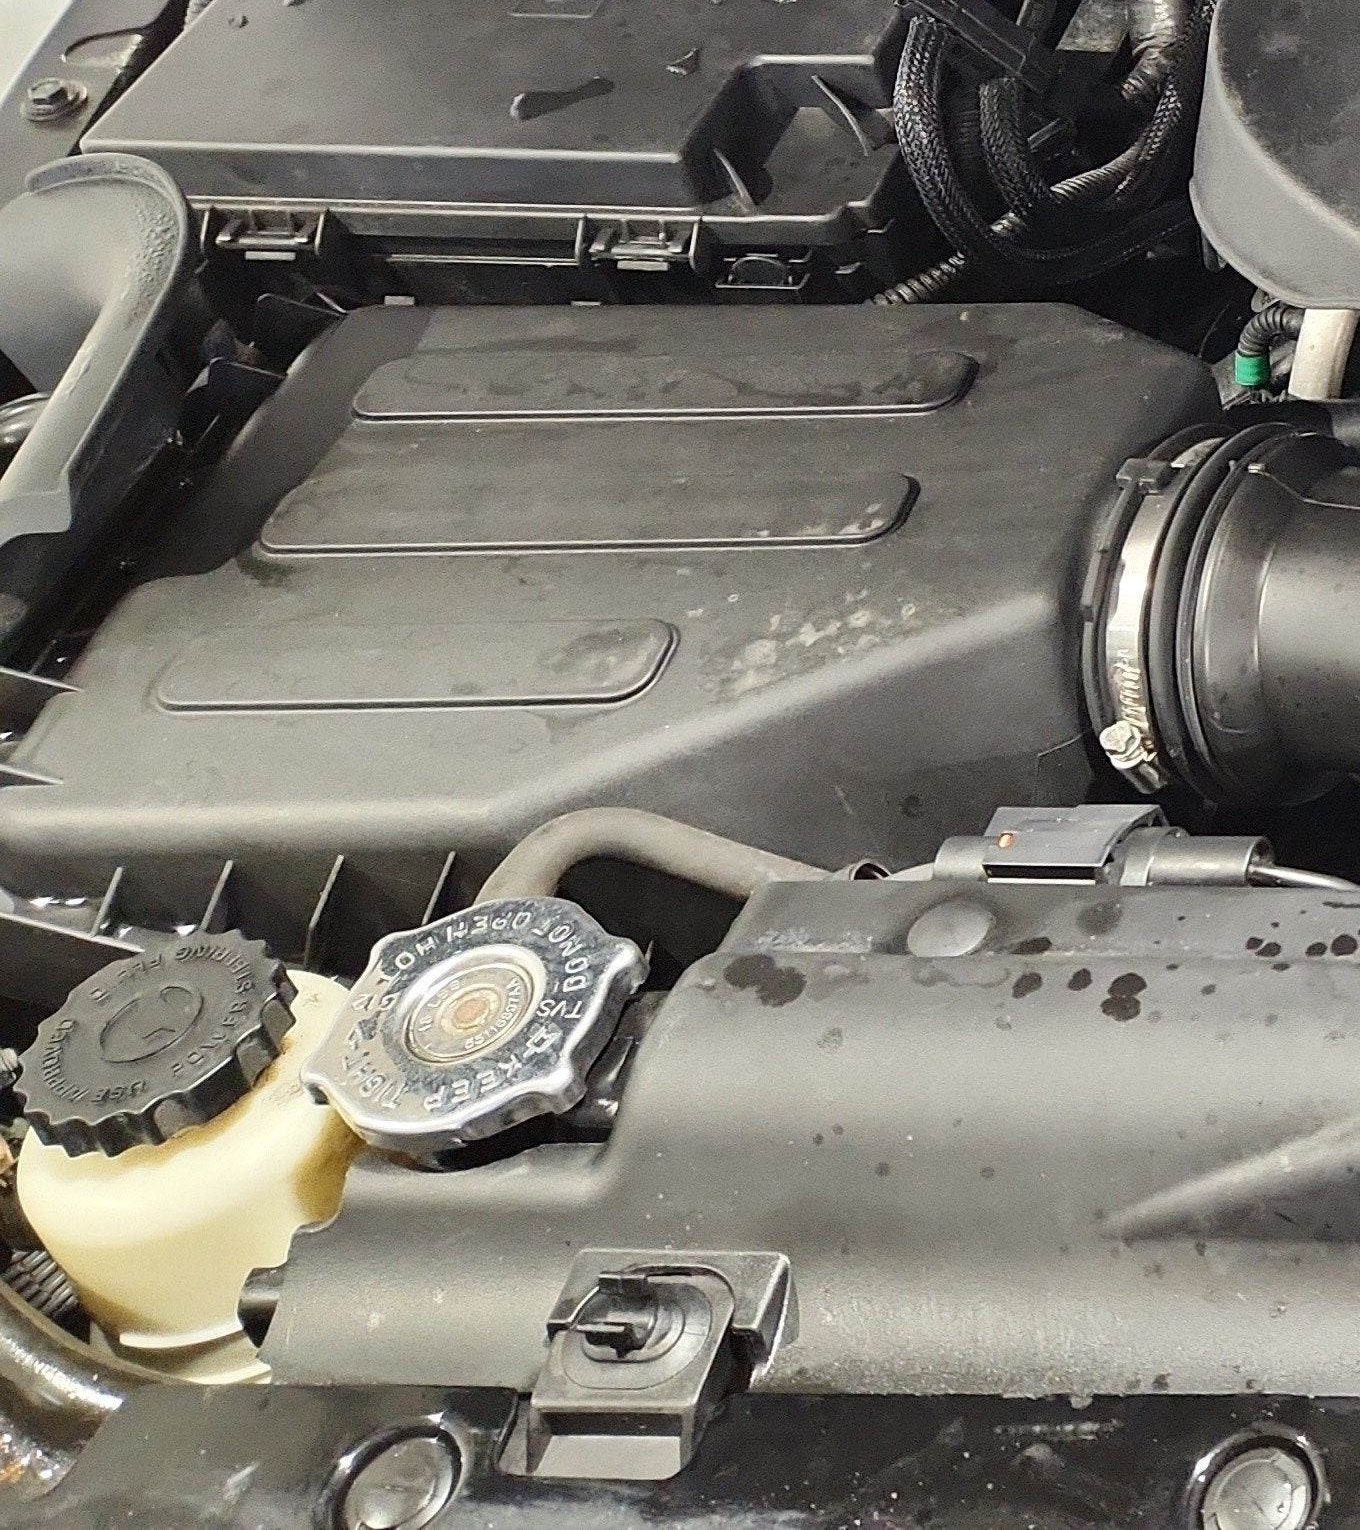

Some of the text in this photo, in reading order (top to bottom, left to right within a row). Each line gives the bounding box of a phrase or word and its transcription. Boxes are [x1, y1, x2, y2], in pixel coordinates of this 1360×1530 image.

[174, 944, 255, 995] STEERING
[376, 911, 590, 994] DO NOT OPEN HOT
[170, 1000, 249, 1078] POWER
[535, 998, 584, 1020] TVS
[341, 1051, 523, 1111] KEEP TIGHT
